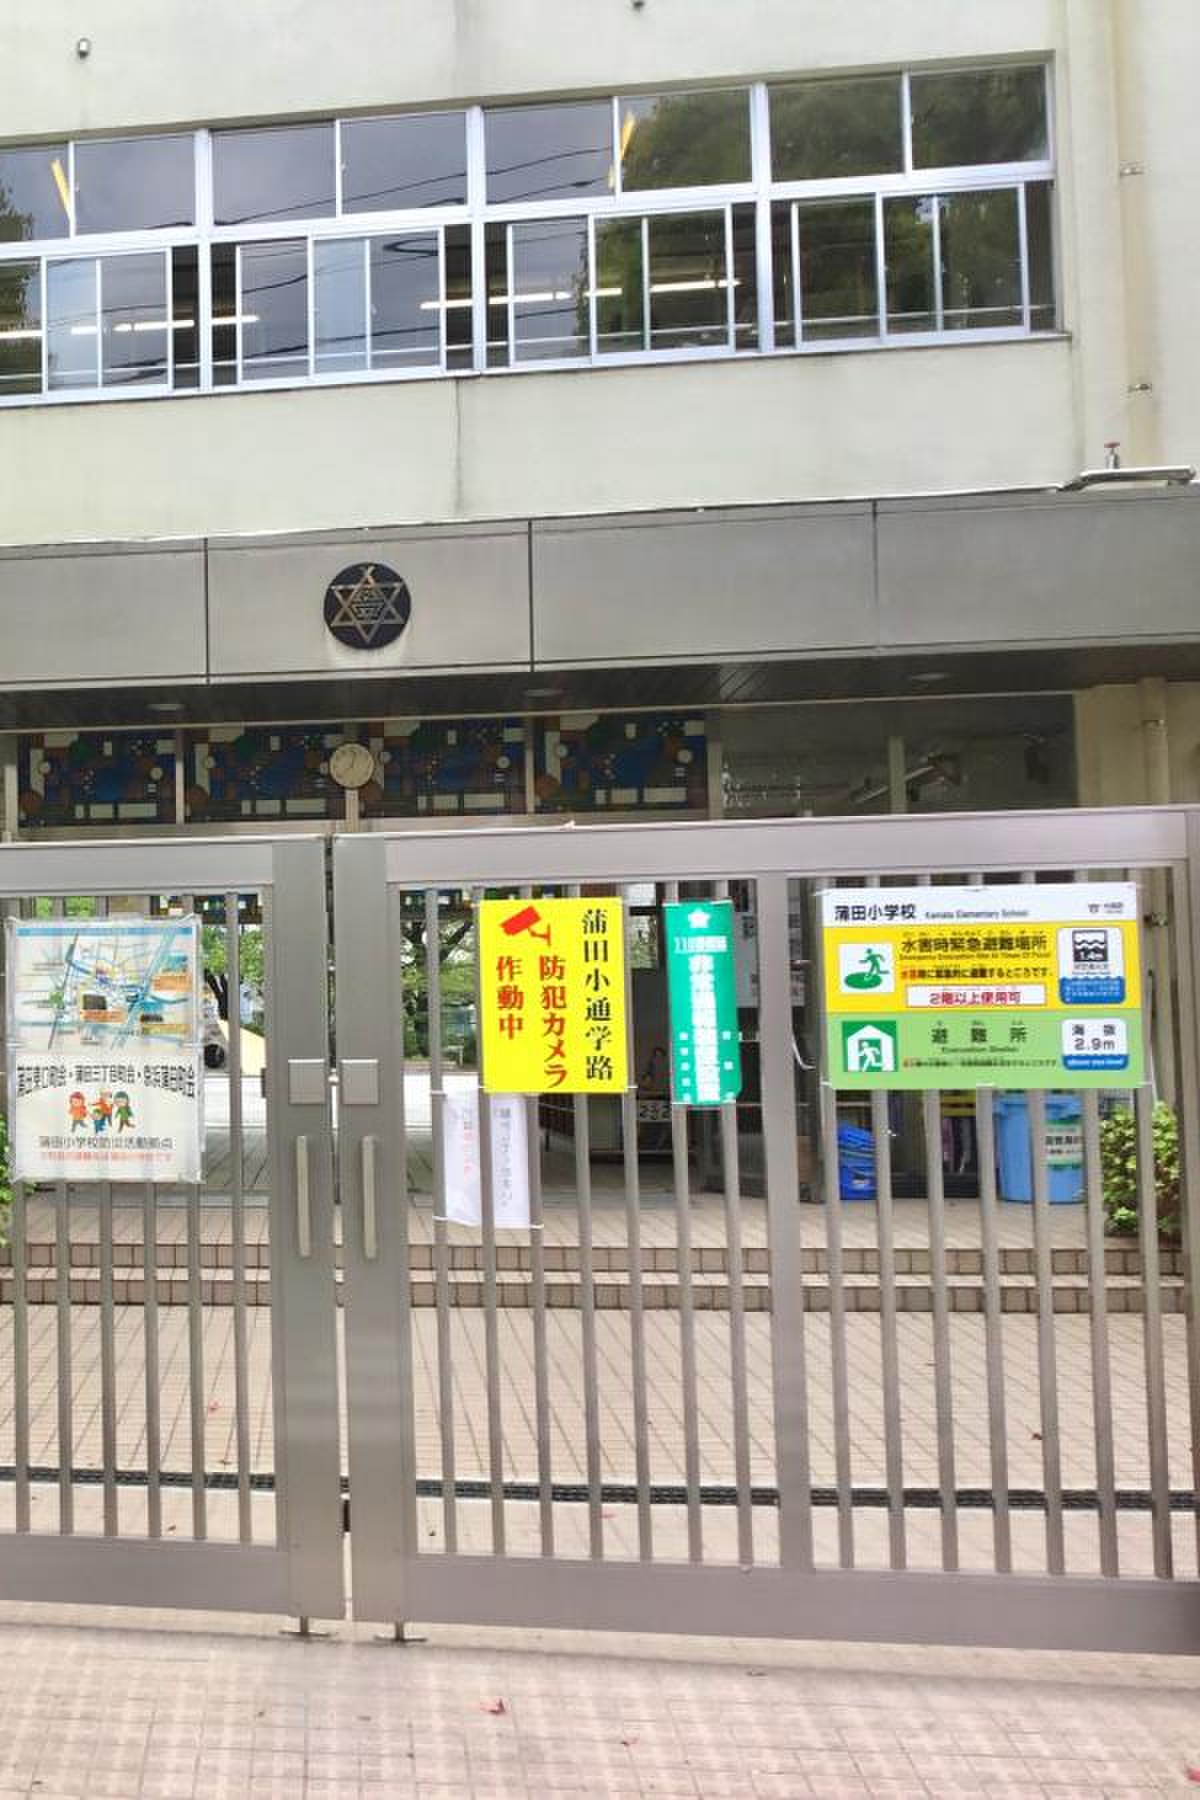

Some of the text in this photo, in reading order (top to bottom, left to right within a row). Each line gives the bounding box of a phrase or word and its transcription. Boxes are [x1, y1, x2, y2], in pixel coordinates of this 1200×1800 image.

[834, 904, 916, 921] 蒲田小学校
[495, 956, 524, 1040] 作動中
[539, 956, 567, 1088] 防犯カメラ
[582, 908, 613, 1081] 蒲田小通学路
[1074, 1038, 1115, 1051] 2.9m
